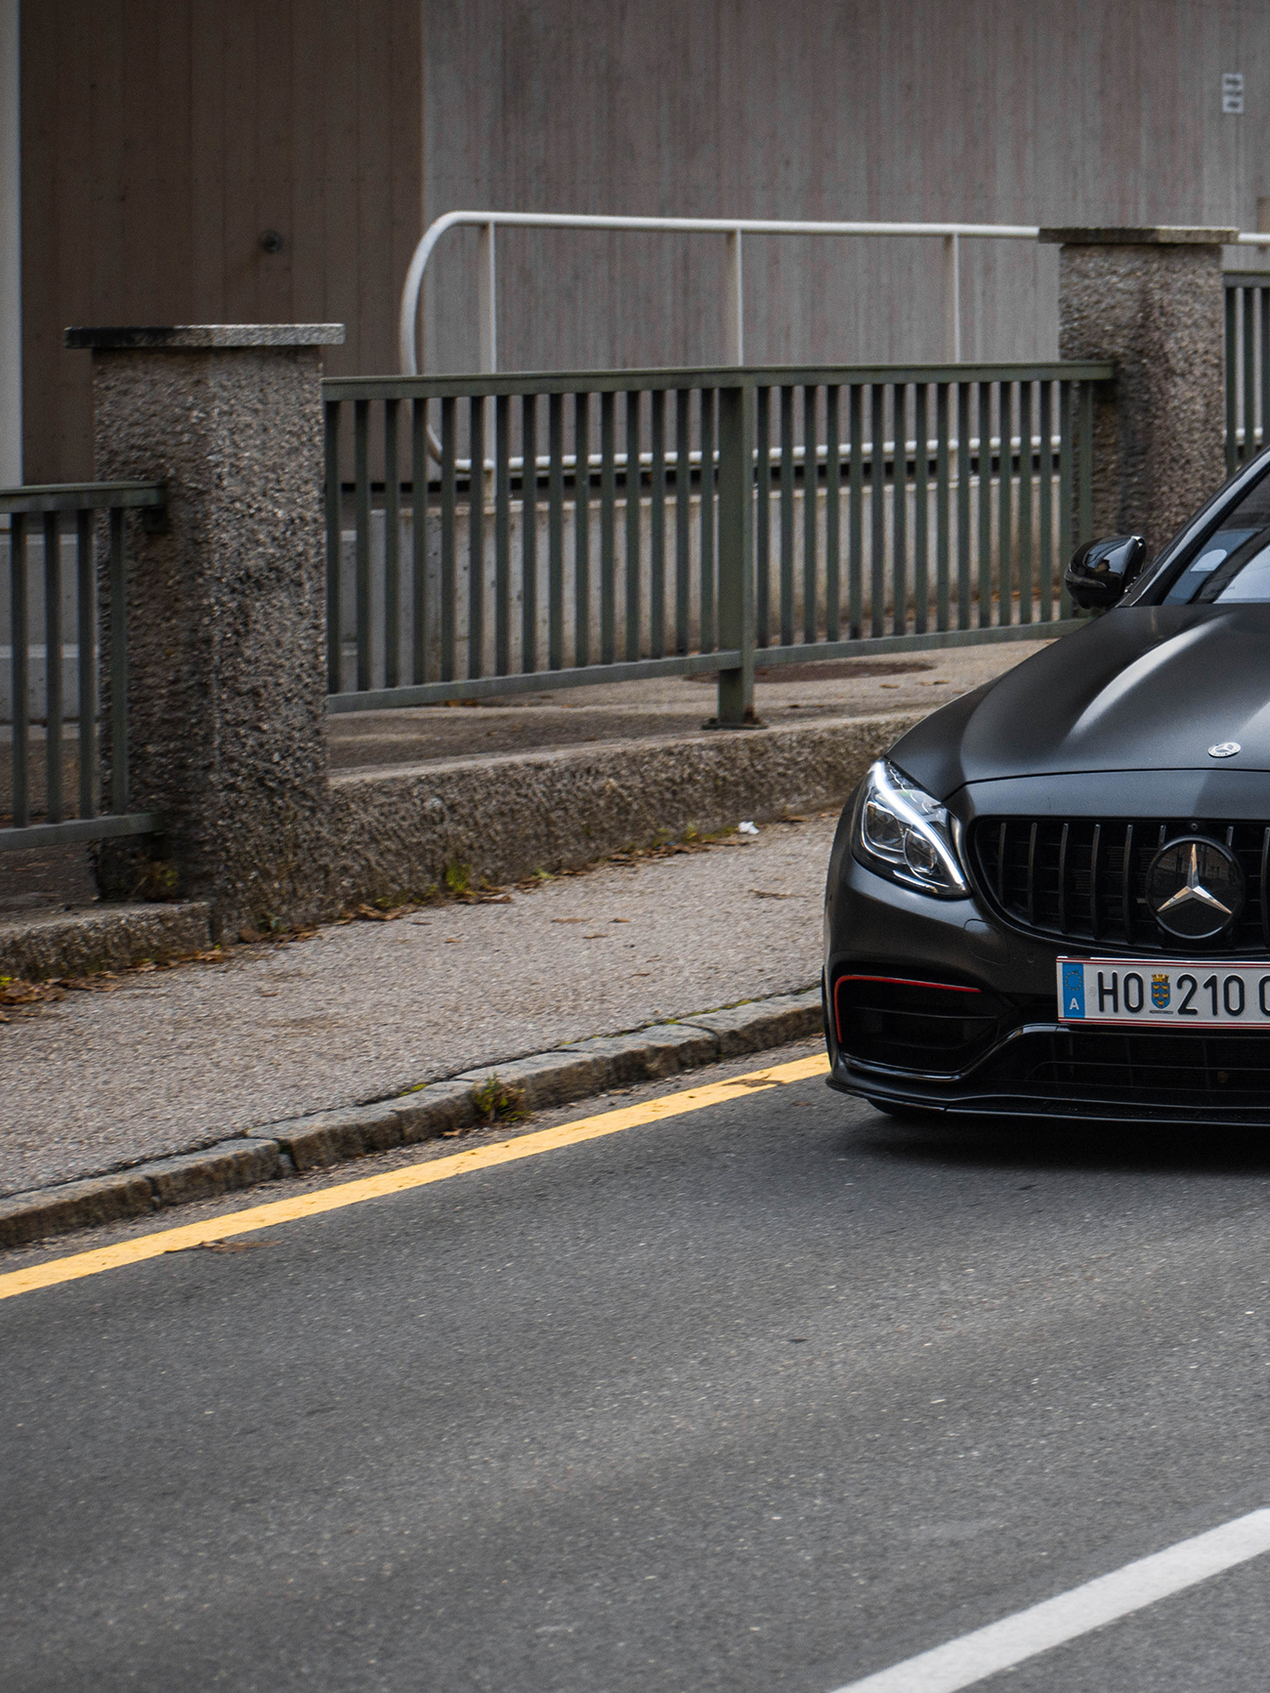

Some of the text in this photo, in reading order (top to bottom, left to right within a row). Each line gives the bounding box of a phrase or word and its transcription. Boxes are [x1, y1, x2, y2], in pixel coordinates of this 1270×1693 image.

[1069, 998, 1080, 1010] A
[1097, 971, 1145, 1014] HO
[1176, 974, 1246, 1017] 210
